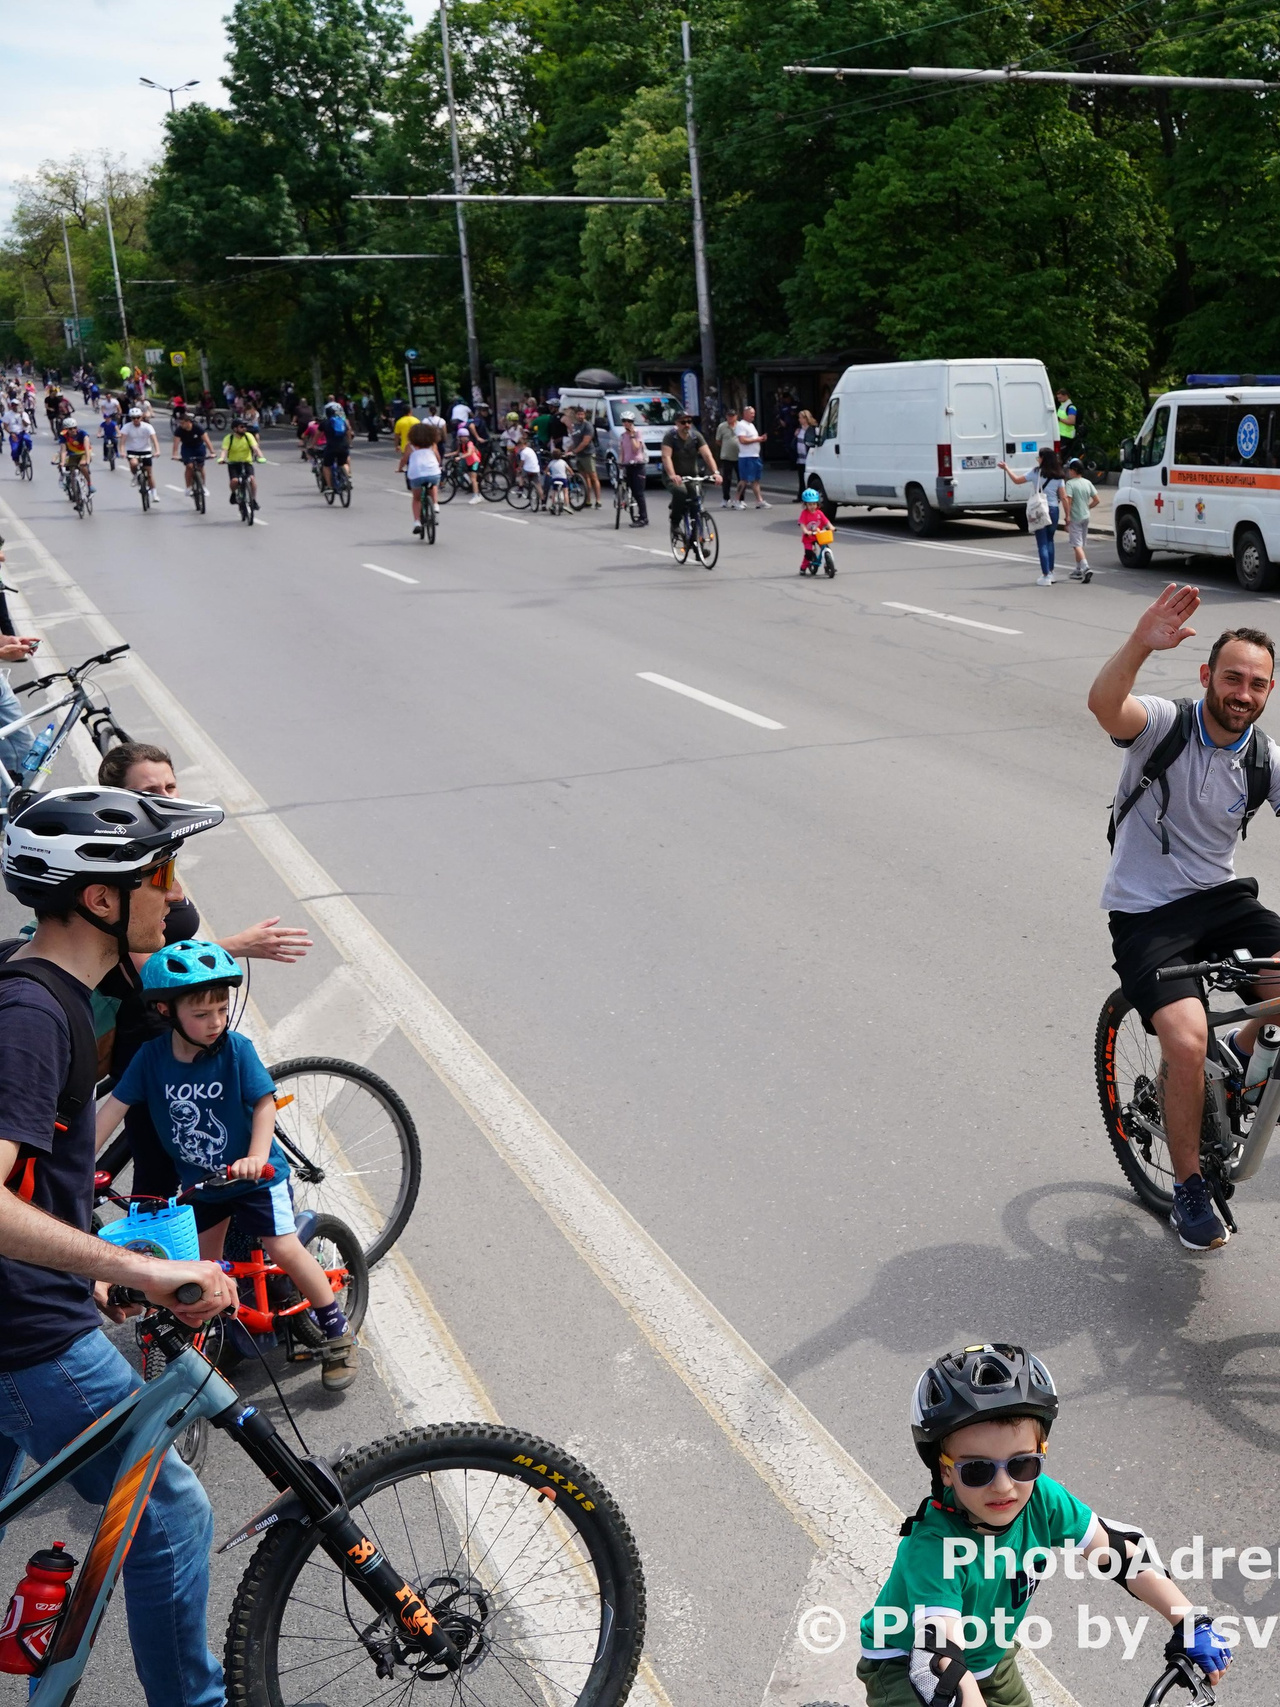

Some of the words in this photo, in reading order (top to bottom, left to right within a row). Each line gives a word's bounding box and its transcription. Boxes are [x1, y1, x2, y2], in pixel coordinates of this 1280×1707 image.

[1177, 472, 1197, 482] ПЪРВА
[1198, 473, 1225, 485] ГРАДСКА
[1225, 475, 1257, 487] БОЛНИЦА
[170, 827, 190, 840] SPEED
[194, 818, 213, 830] STYLE
[165, 1081, 224, 1101] KOKO
[512, 1454, 597, 1512] MAXXIS
[254, 1513, 279, 1531] GUARD
[347, 1537, 376, 1564] 36
[394, 1582, 439, 1636] FOX
